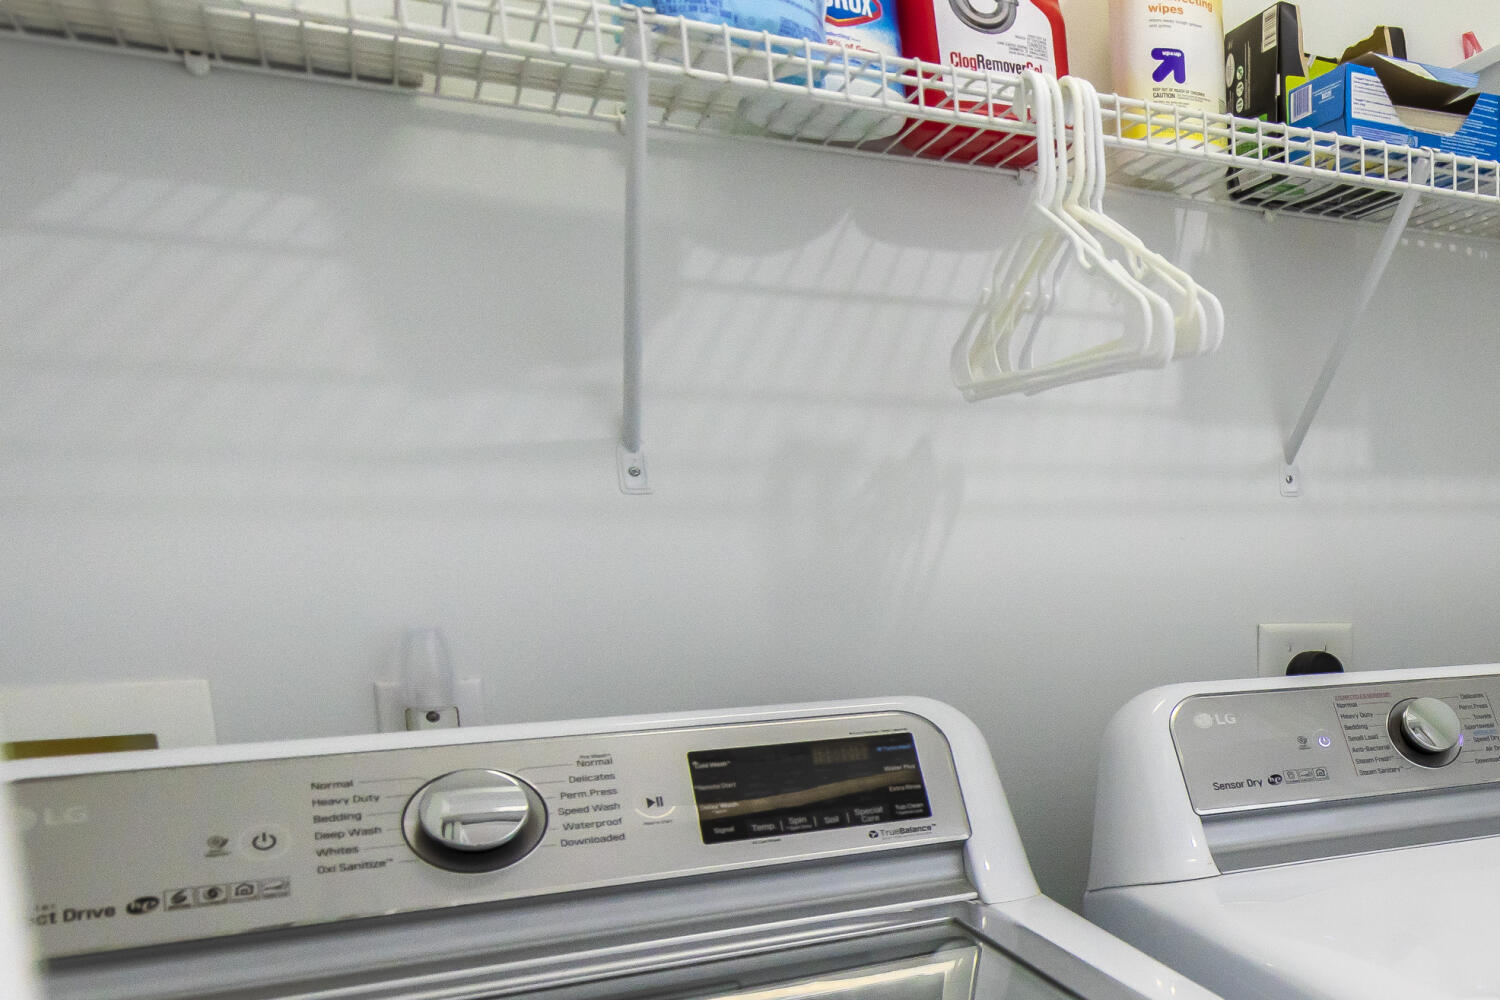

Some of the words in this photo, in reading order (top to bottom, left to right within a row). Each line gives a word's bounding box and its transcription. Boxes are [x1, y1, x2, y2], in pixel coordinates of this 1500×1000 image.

[824, 0, 872, 18] OX
[1148, 3, 1184, 15] wipes
[1214, 712, 1237, 725] LG
[576, 758, 613, 768] Normal
[568, 773, 616, 784] Delicates
[1212, 780, 1244, 791] Sensor
[1247, 779, 1262, 788] Dry
[311, 780, 353, 791] Normal
[312, 797, 349, 808] Heavy
[353, 794, 380, 804] Duty
[558, 806, 589, 817] Speed
[592, 803, 620, 812] Wash
[313, 812, 362, 824] Bedding
[562, 817, 622, 832] Waterproof
[315, 831, 345, 841] Deep
[348, 826, 382, 837] Wash
[560, 833, 626, 848] Downloaded
[316, 846, 359, 857] Whites
[63, 906, 116, 922] Drive
